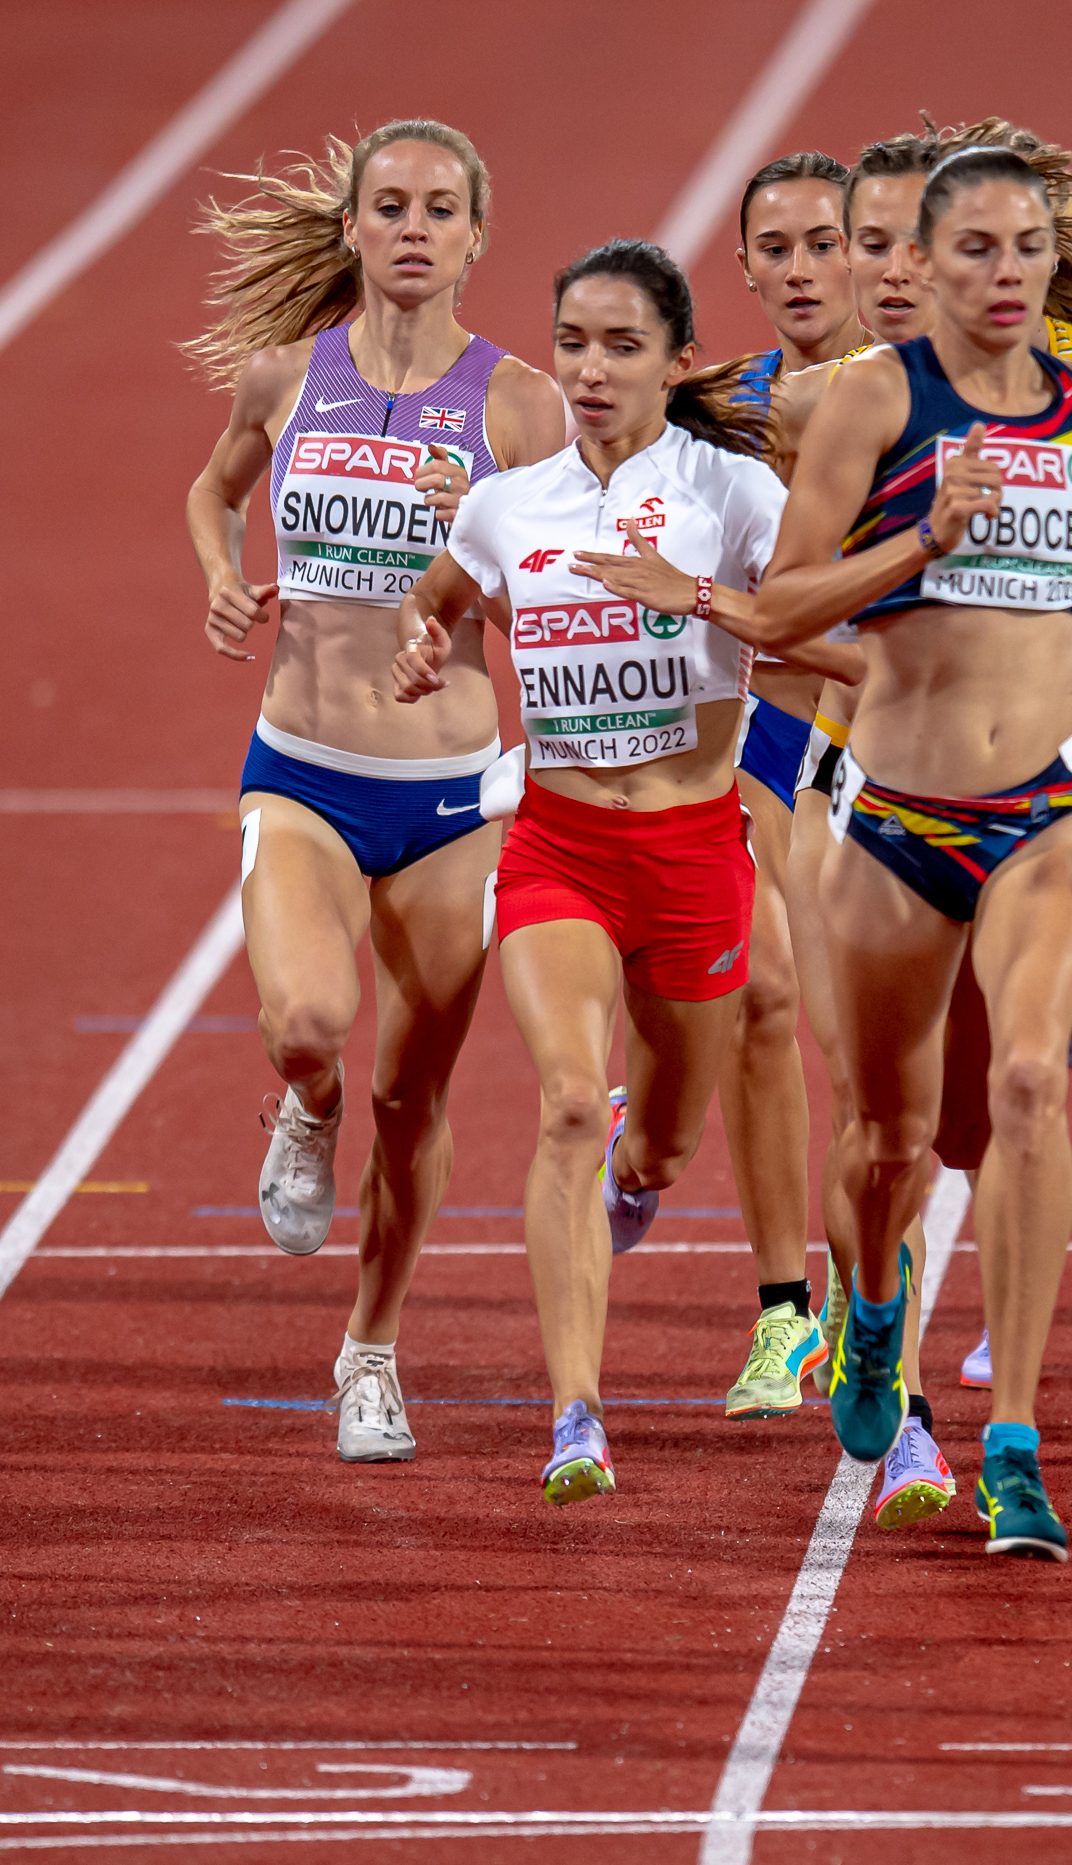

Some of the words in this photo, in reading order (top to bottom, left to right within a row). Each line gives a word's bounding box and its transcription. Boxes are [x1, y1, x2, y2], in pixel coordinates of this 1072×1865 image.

[294, 441, 417, 479] SPAR
[945, 447, 1064, 484] PAR
[618, 515, 663, 529] OLEN
[317, 543, 323, 556] I
[325, 544, 352, 561] RUN
[518, 549, 565, 573] 4F
[291, 560, 374, 592] MUNICH
[384, 573, 420, 595] 20
[935, 573, 1037, 602] MUNICH
[517, 605, 636, 643] SPAR
[519, 656, 690, 709] ENNAOUI
[562, 717, 591, 733] RUN
[538, 737, 618, 761] MUNICH
[627, 726, 687, 758] 2022
